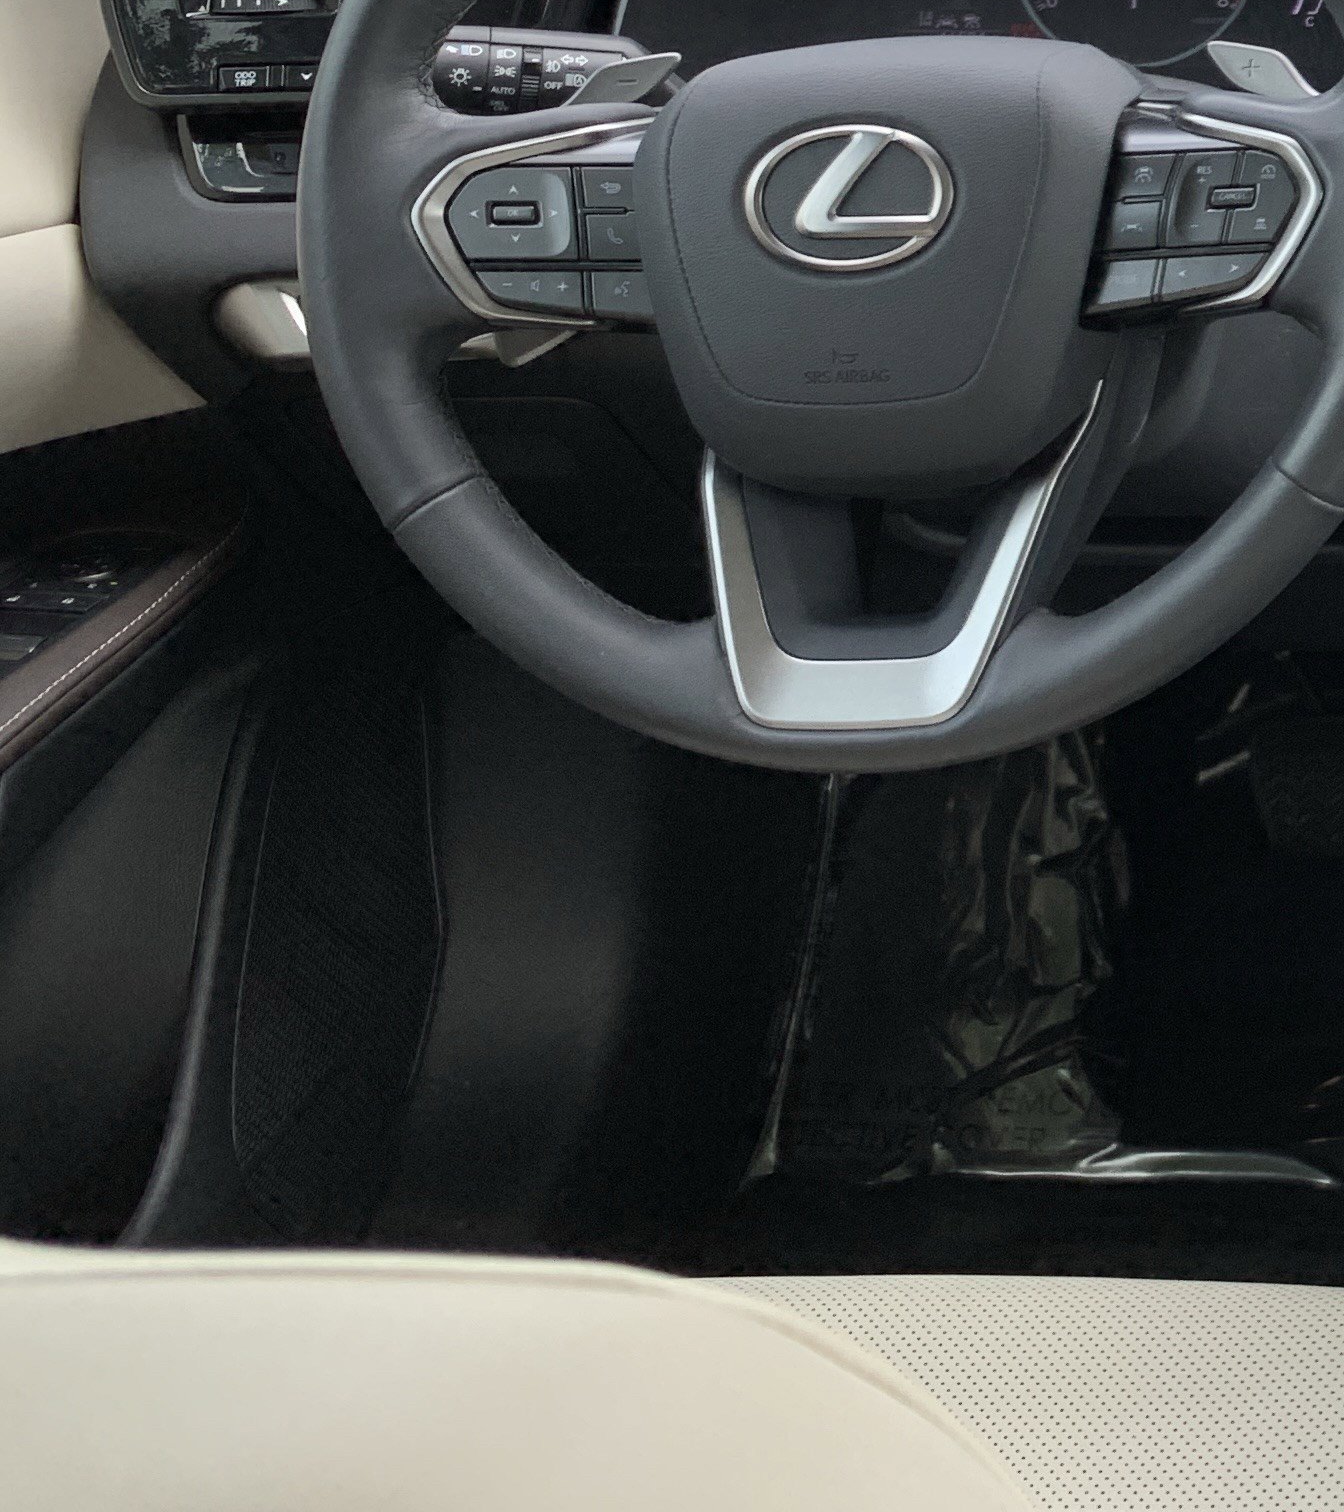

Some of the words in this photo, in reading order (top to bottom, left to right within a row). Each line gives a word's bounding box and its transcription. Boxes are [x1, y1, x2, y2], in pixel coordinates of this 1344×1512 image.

[1304, 16, 1316, 29] C
[234, 70, 257, 80] ODO
[234, 79, 256, 88] TRIP
[543, 81, 564, 91] OFF
[490, 86, 516, 96] AUTO
[1196, 165, 1213, 176] RES
